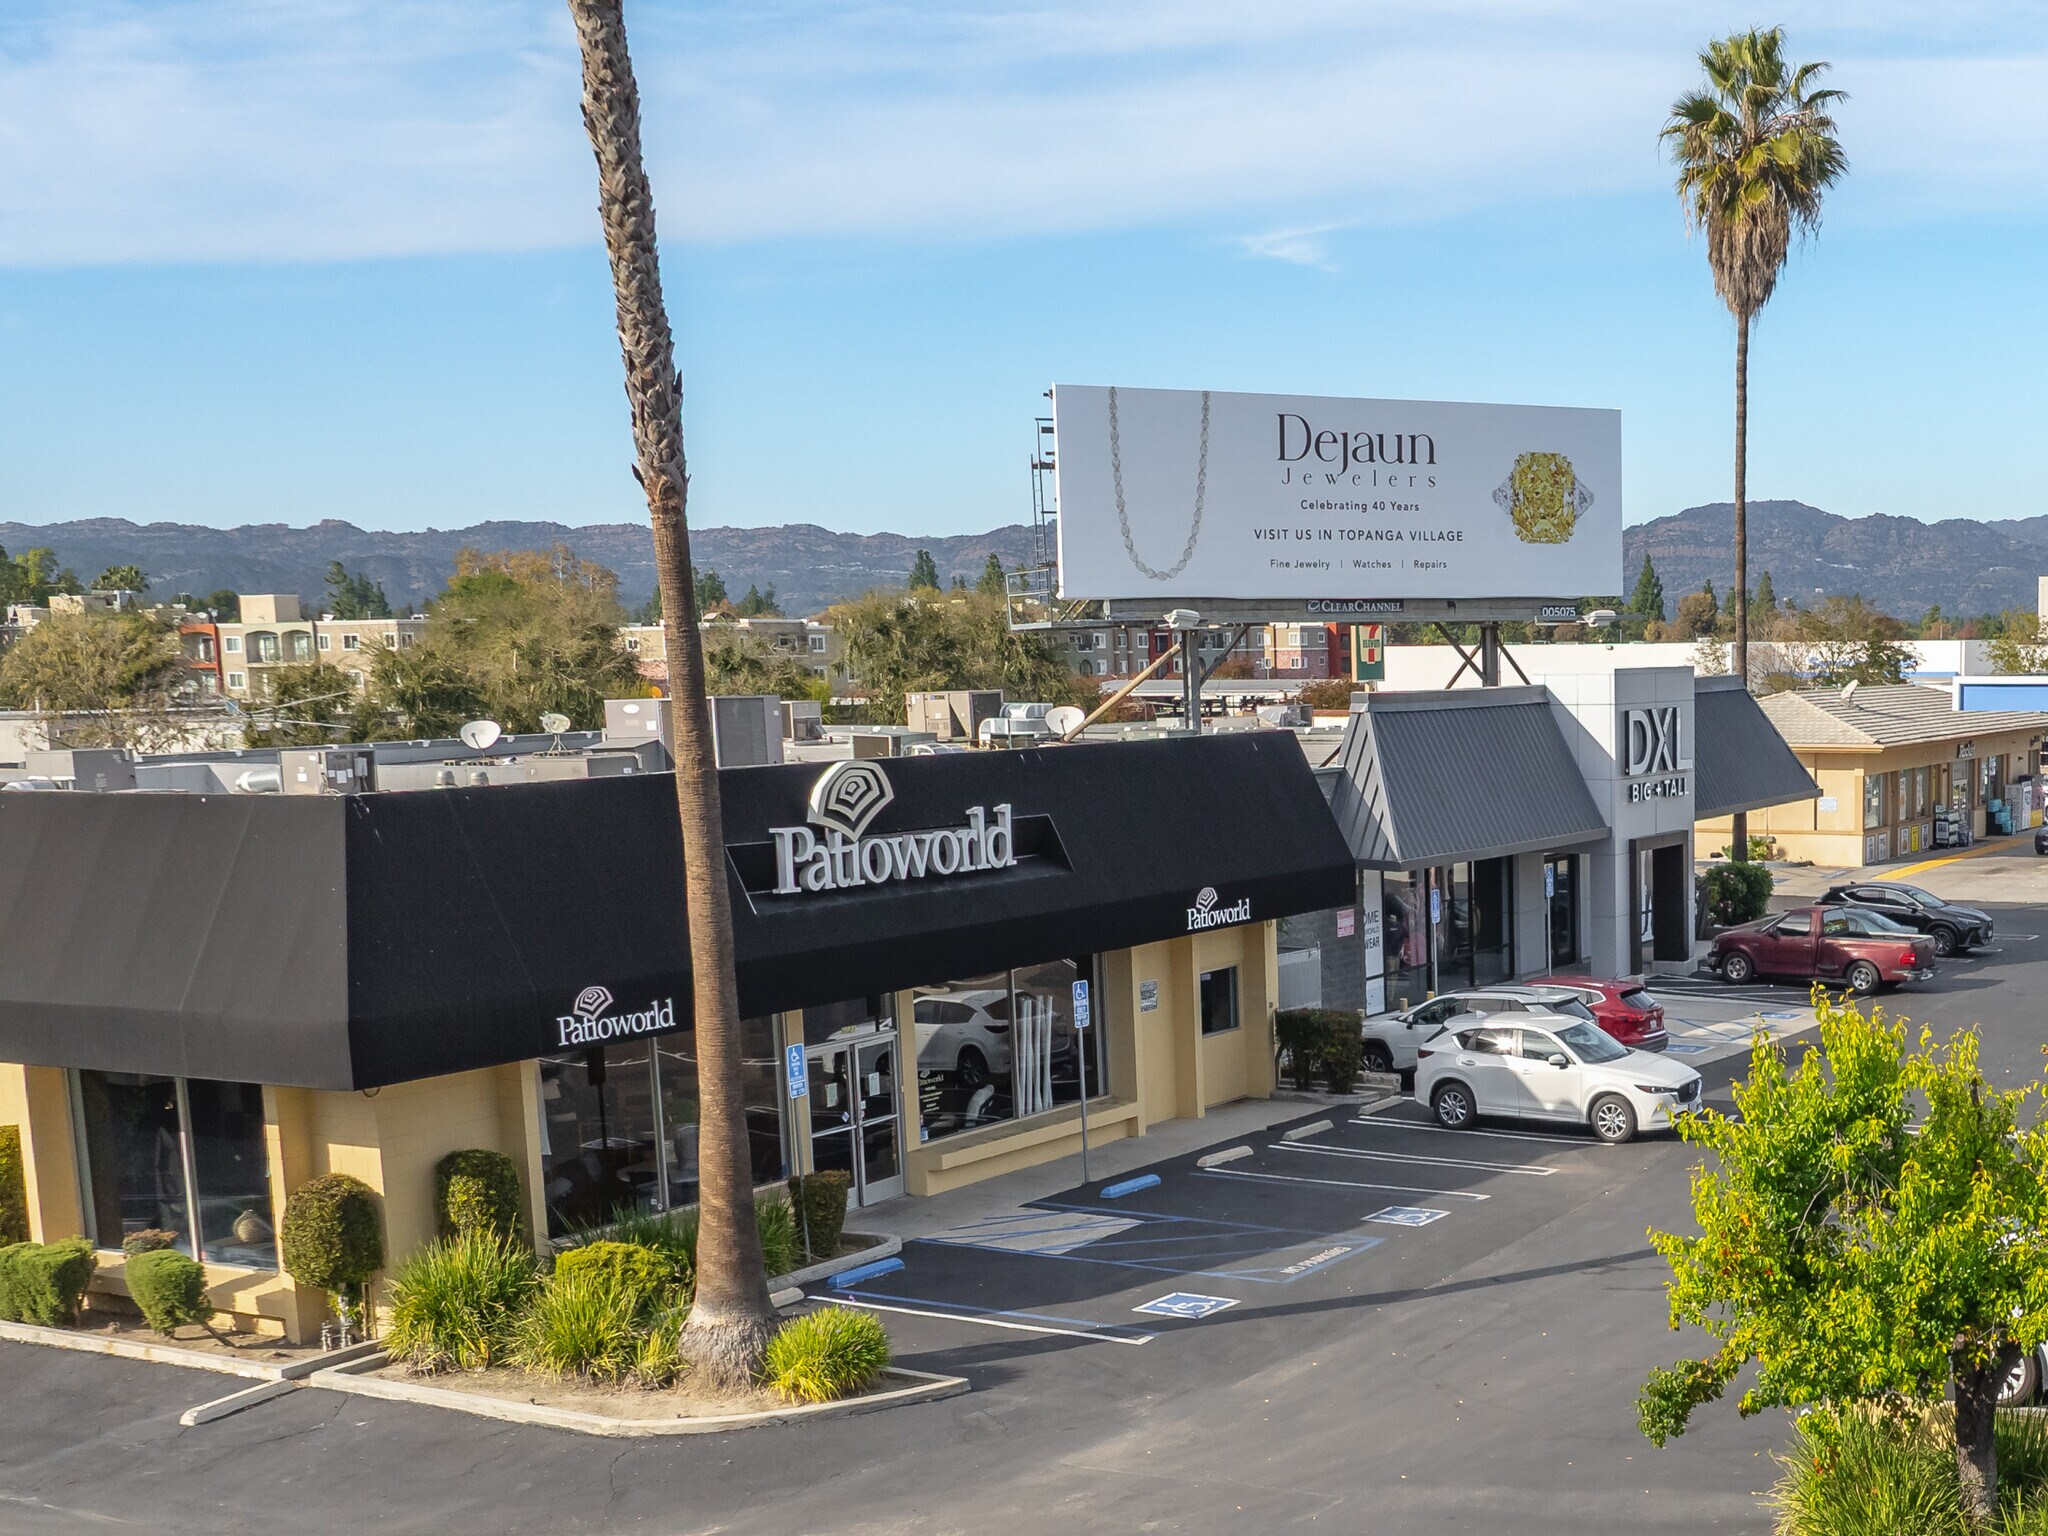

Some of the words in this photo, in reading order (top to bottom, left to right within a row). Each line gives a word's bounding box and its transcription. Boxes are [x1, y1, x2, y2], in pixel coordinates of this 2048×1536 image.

[1276, 413, 1437, 476] Dejaun
[1281, 467, 1437, 488] Jewelers
[1300, 499, 1368, 513] Celebrating
[1372, 501, 1386, 511] 40
[1390, 501, 1420, 512] Years
[1254, 529, 1289, 540] VISIT
[1295, 529, 1312, 540] US
[1318, 529, 1333, 541] IN
[1339, 529, 1404, 542] TOPANGA
[1409, 530, 1464, 542] VILLAGE
[1270, 559, 1290, 569] Fine
[1294, 559, 1330, 571] Jewelry
[1352, 559, 1392, 569] Watches
[1413, 560, 1448, 571] Repairs
[1542, 607, 1576, 617] 005075
[1626, 707, 1693, 775] DXL
[1630, 782, 1651, 802] BIG
[1663, 777, 1690, 798] TALL
[769, 803, 1017, 894] Patioworld
[1186, 897, 1251, 930] Patioworld
[556, 997, 677, 1047] Patioworld
[1280, 1265, 1306, 1275] NO
